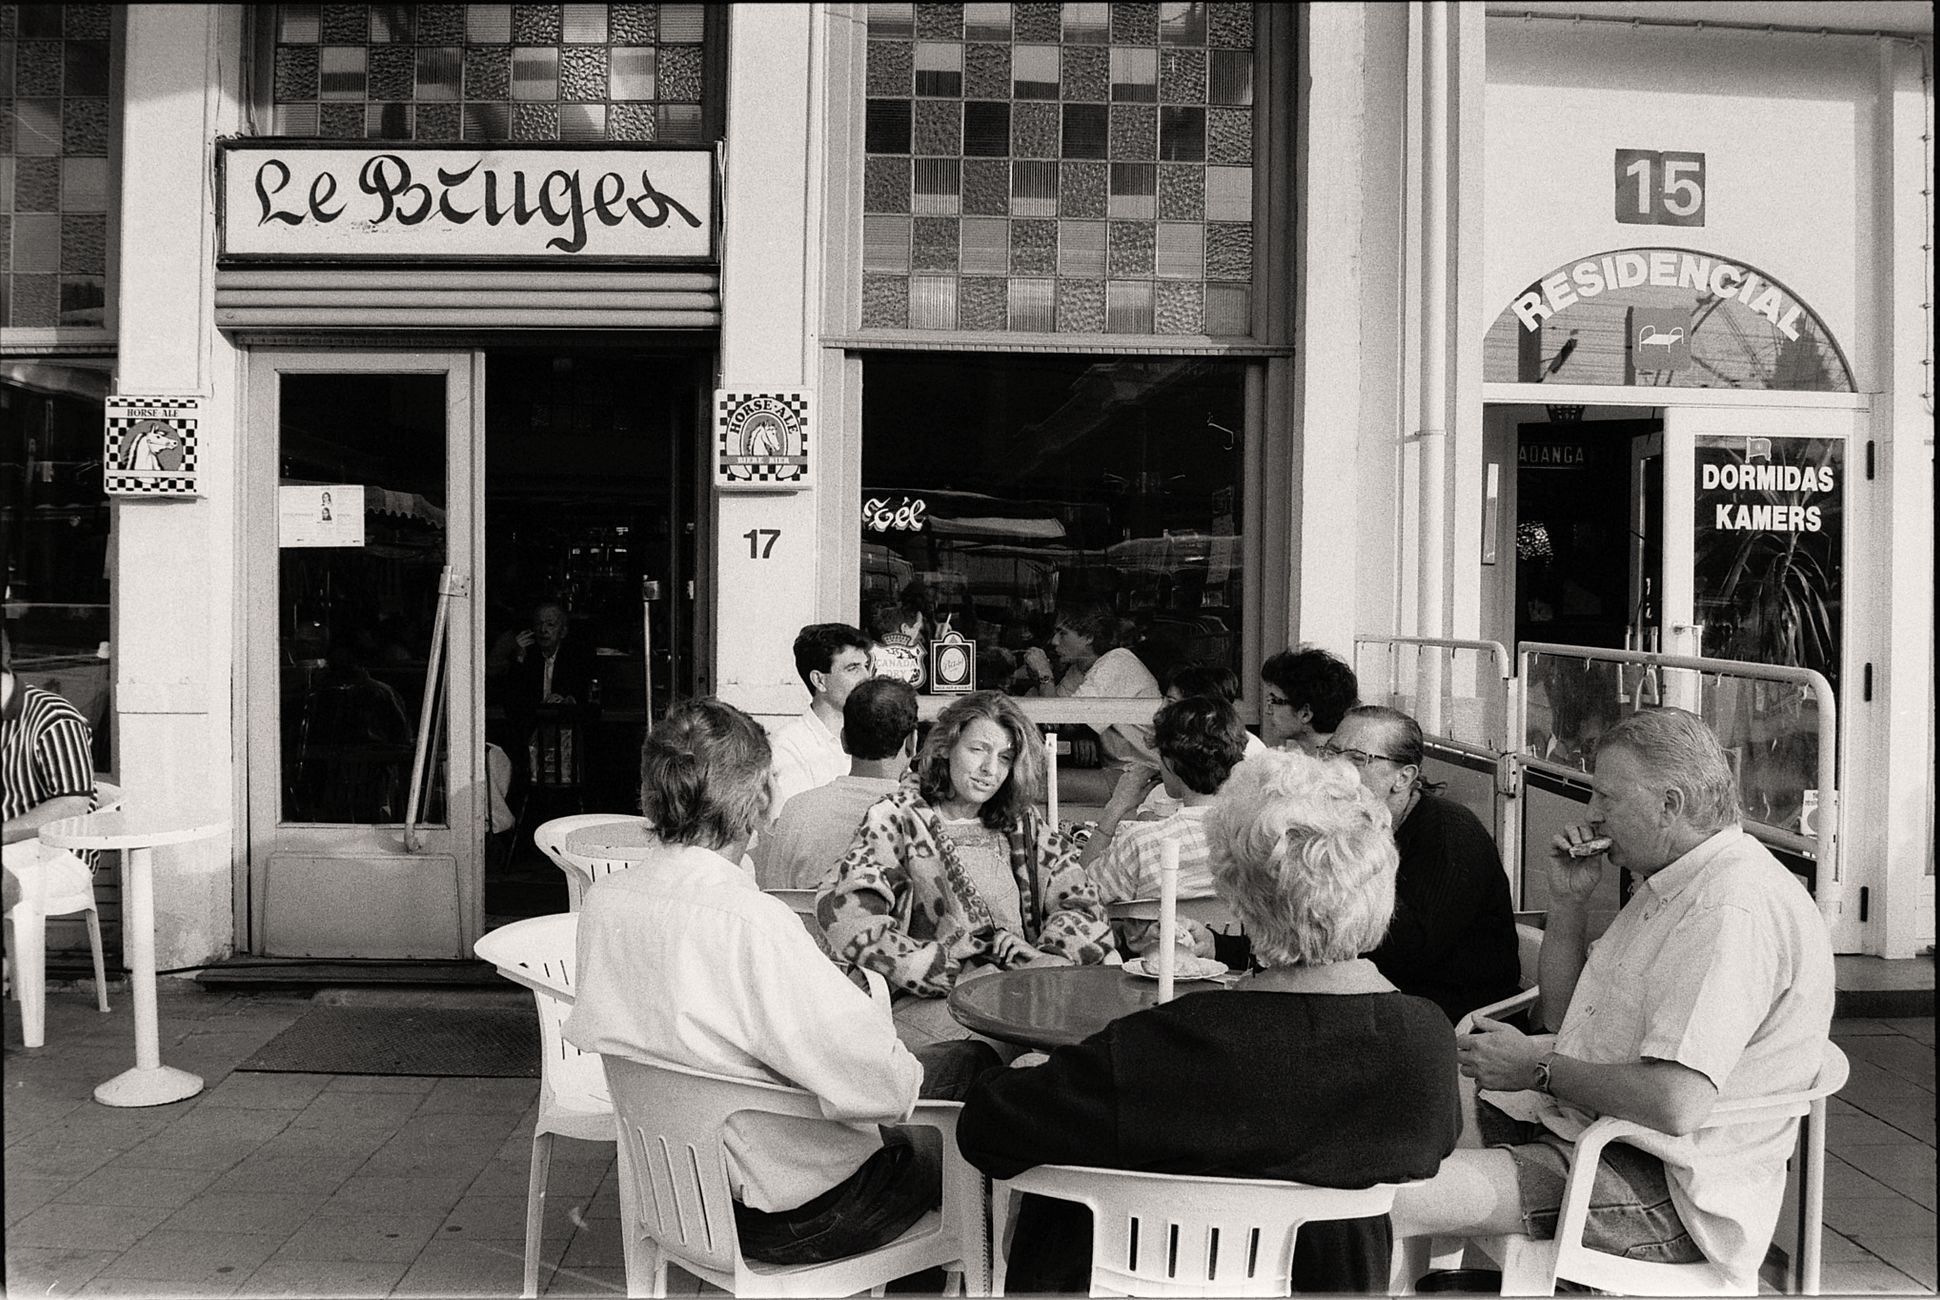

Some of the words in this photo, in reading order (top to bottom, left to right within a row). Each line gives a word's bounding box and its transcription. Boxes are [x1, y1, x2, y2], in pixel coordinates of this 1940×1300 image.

[1626, 159, 1703, 216] 15
[255, 158, 348, 227] Le
[358, 154, 702, 253] Bruges
[1511, 252, 1802, 342] RESIDENCIAL
[127, 408, 158, 417] HORSE
[162, 409, 179, 417] ALE
[1702, 463, 1835, 493] DORMIDAS
[1715, 503, 1822, 533] KAMERS
[743, 528, 782, 559] 17
